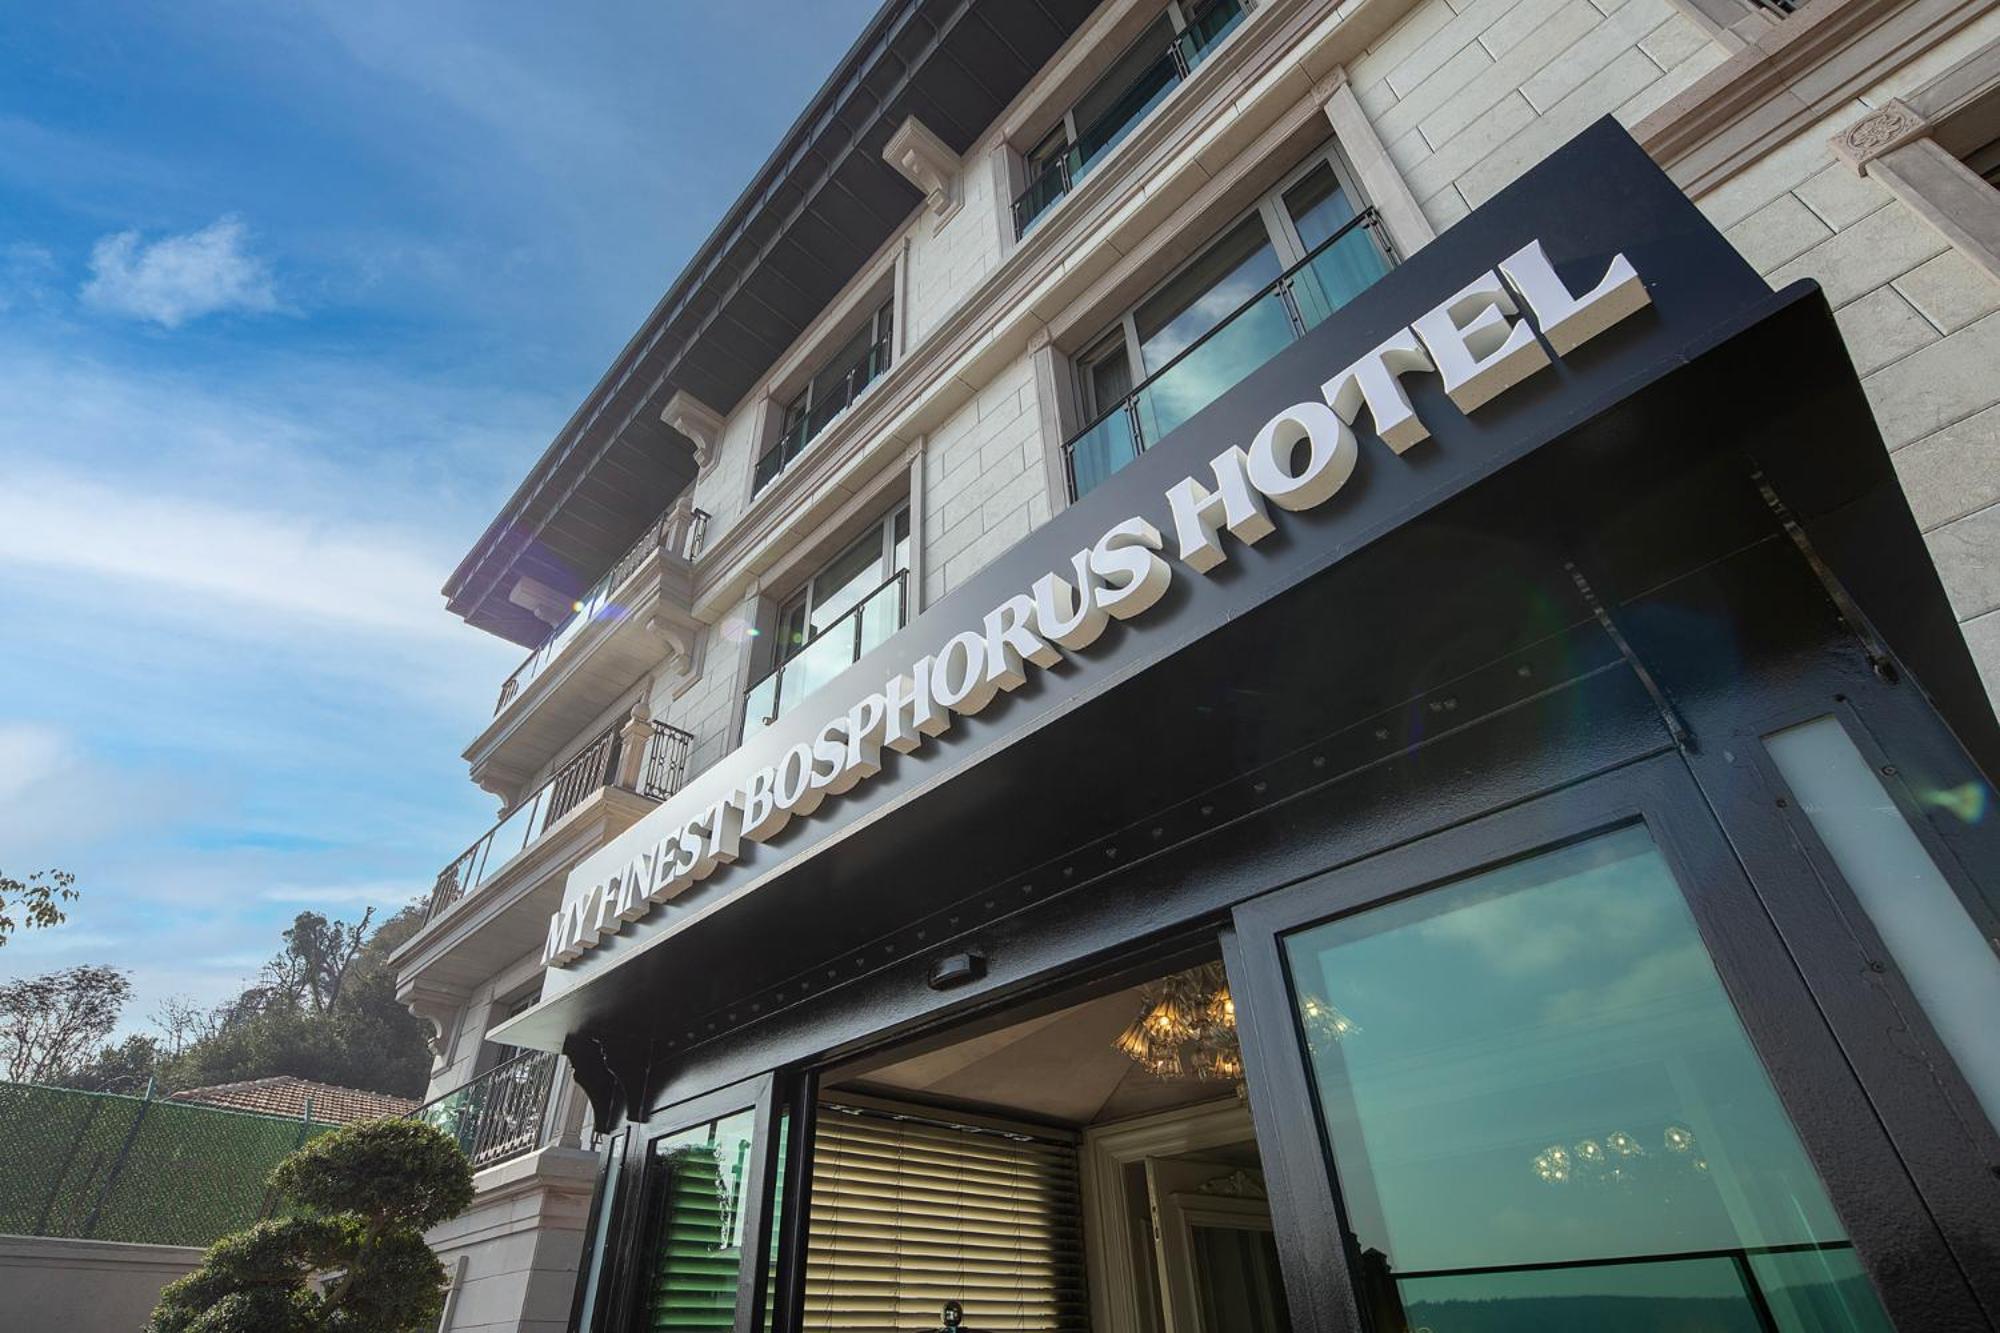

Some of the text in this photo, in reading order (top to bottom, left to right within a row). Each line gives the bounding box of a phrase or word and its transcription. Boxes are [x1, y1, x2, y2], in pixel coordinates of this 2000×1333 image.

[541, 239, 1652, 967] MY FINEST BOSPHORUS HOTEL
